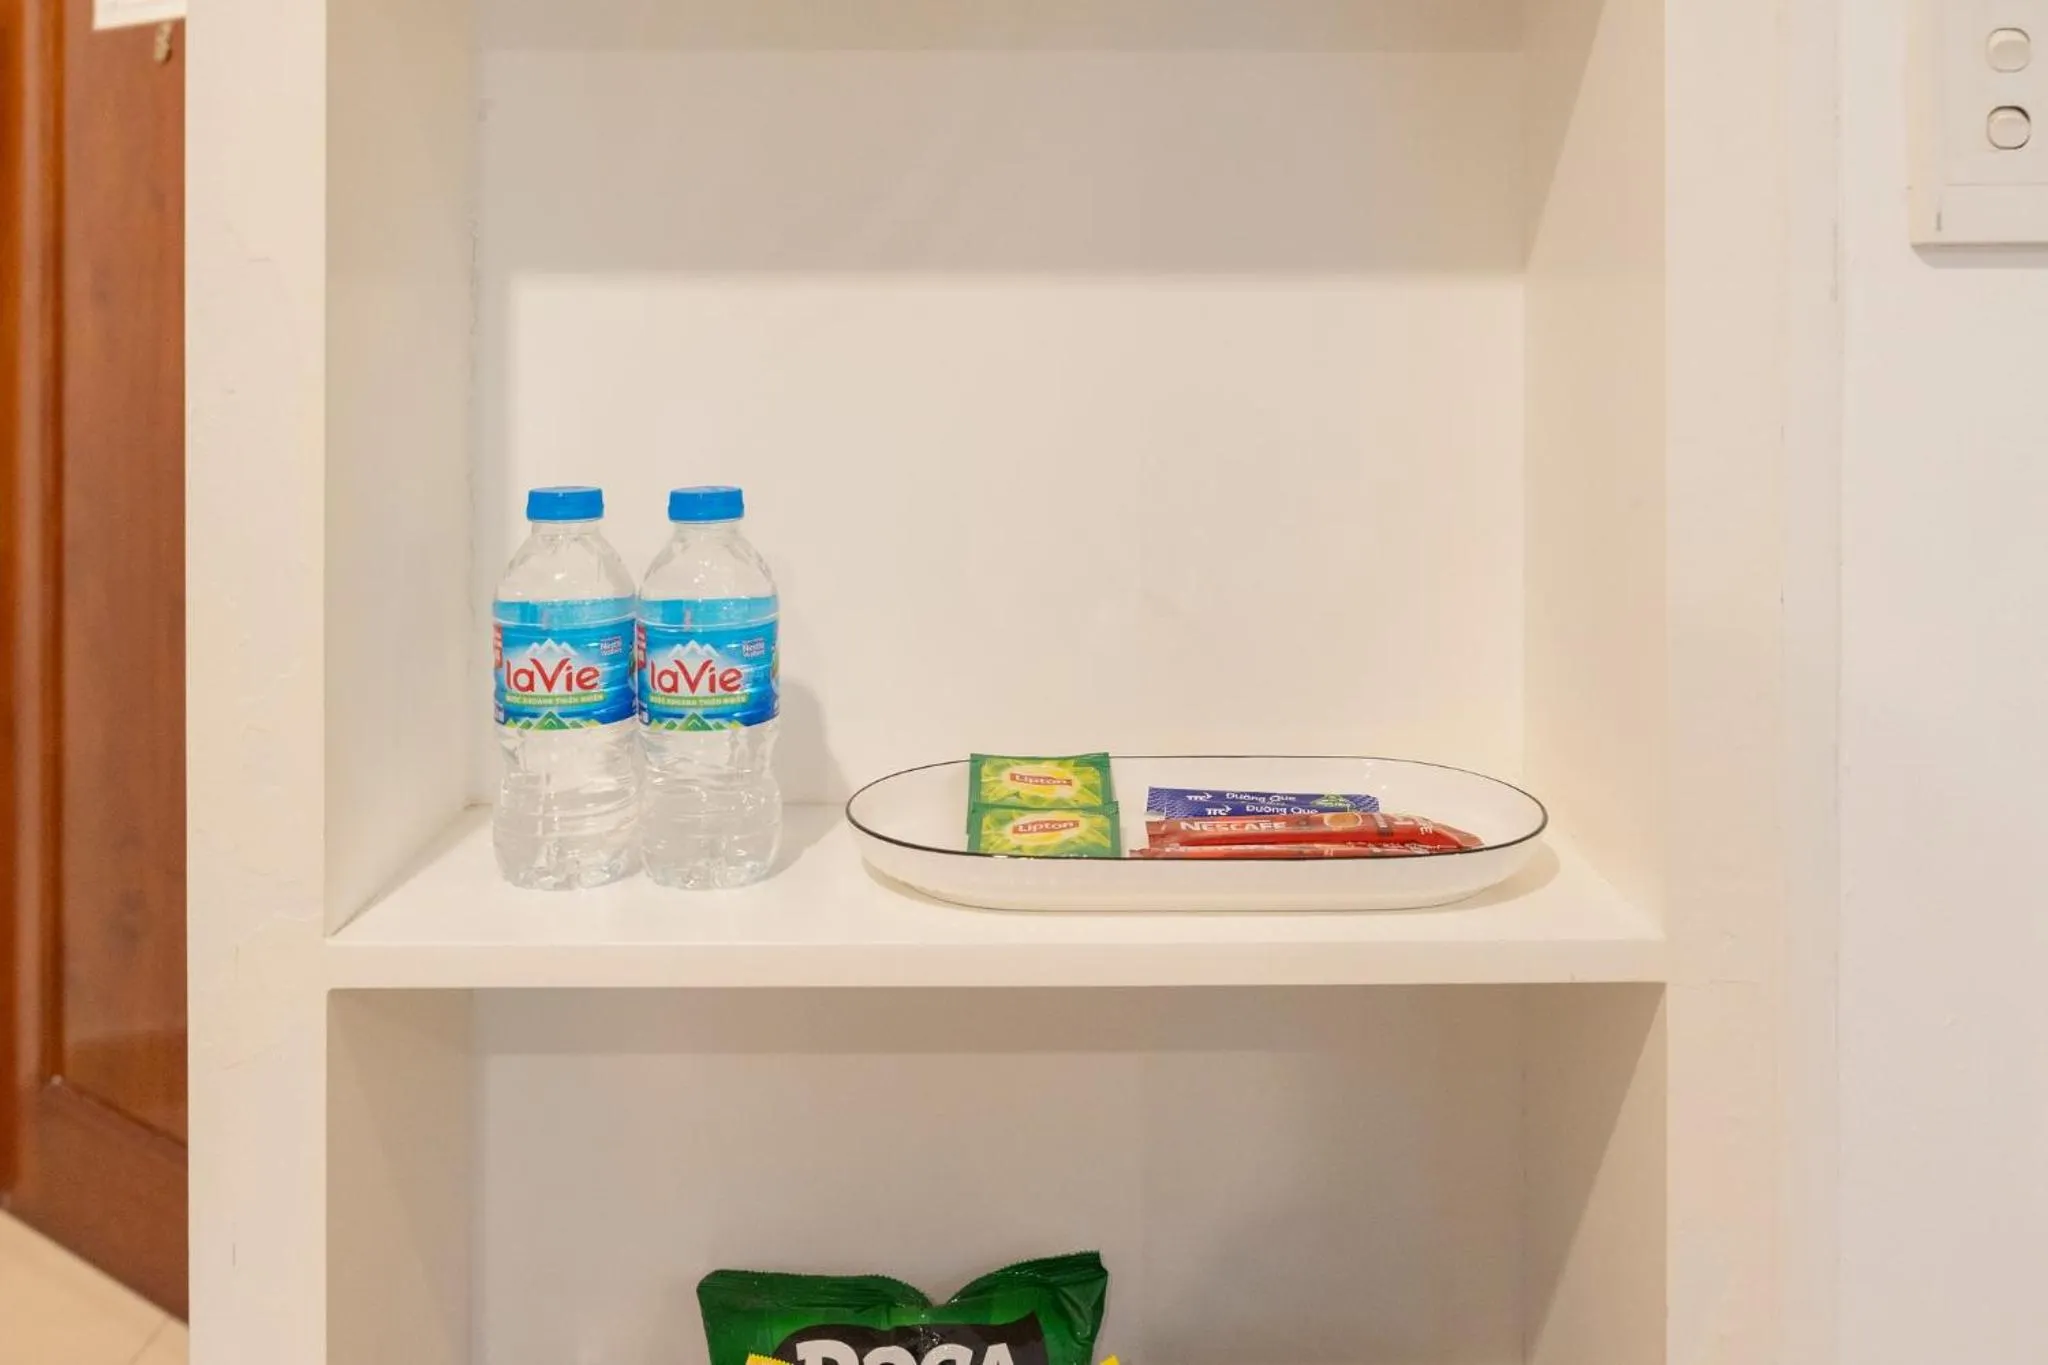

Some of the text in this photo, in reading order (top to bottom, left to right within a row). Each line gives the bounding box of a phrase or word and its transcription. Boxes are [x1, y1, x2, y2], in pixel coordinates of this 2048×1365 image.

[506, 658, 600, 693] laVie
[650, 659, 743, 694] laVie
[1015, 774, 1068, 786] Lipton
[1017, 821, 1074, 833] Lipton
